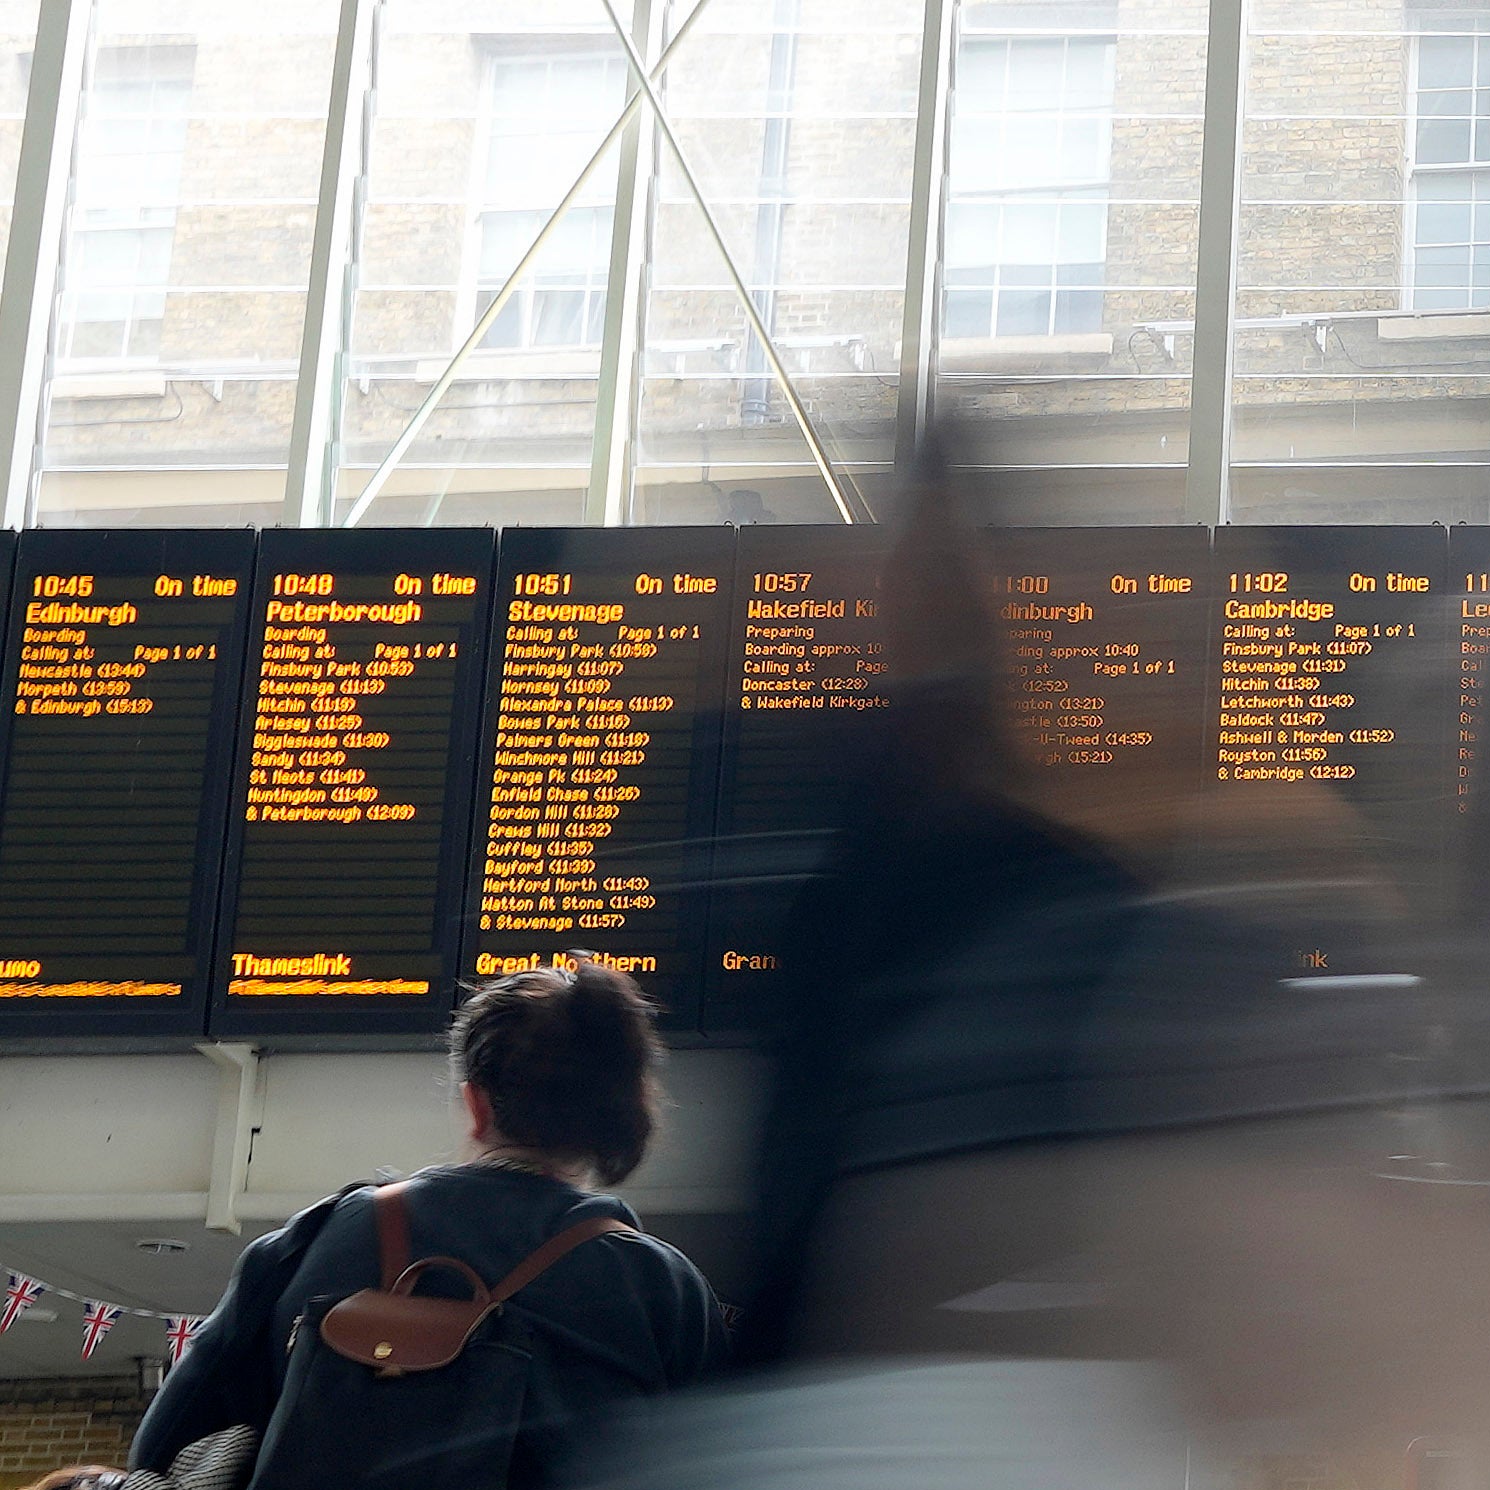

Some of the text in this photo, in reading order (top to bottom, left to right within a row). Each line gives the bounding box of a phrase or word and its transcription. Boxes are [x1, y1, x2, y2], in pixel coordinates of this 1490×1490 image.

[33, 575, 94, 597] 10:45
[154, 575, 238, 597] On time
[274, 573, 335, 596] 10:48
[393, 573, 477, 596] On time
[515, 573, 572, 596] 10:51
[634, 573, 717, 595] On time
[754, 573, 812, 593] 10:57
[1110, 575, 1192, 593] On time
[1229, 573, 1288, 593] 11:02
[1348, 572, 1429, 593] On time
[25, 602, 138, 626] Edinburgh
[266, 600, 423, 625] Peterborough
[509, 600, 625, 624] Stevenage
[747, 600, 846, 619] Wakefield
[1000, 602, 1094, 624] dinburgh
[1224, 601, 1334, 622] Cambridge
[23, 627, 87, 645] Boarding
[746, 624, 815, 641] Preparing
[745, 642, 859, 658] Boarding approx
[1219, 711, 1323, 727] Baldock (11:47)
[1218, 747, 1326, 765] Royston (11:56)
[0, 960, 42, 978] umo
[232, 953, 351, 976] Thameslink
[476, 952, 541, 975] Great
